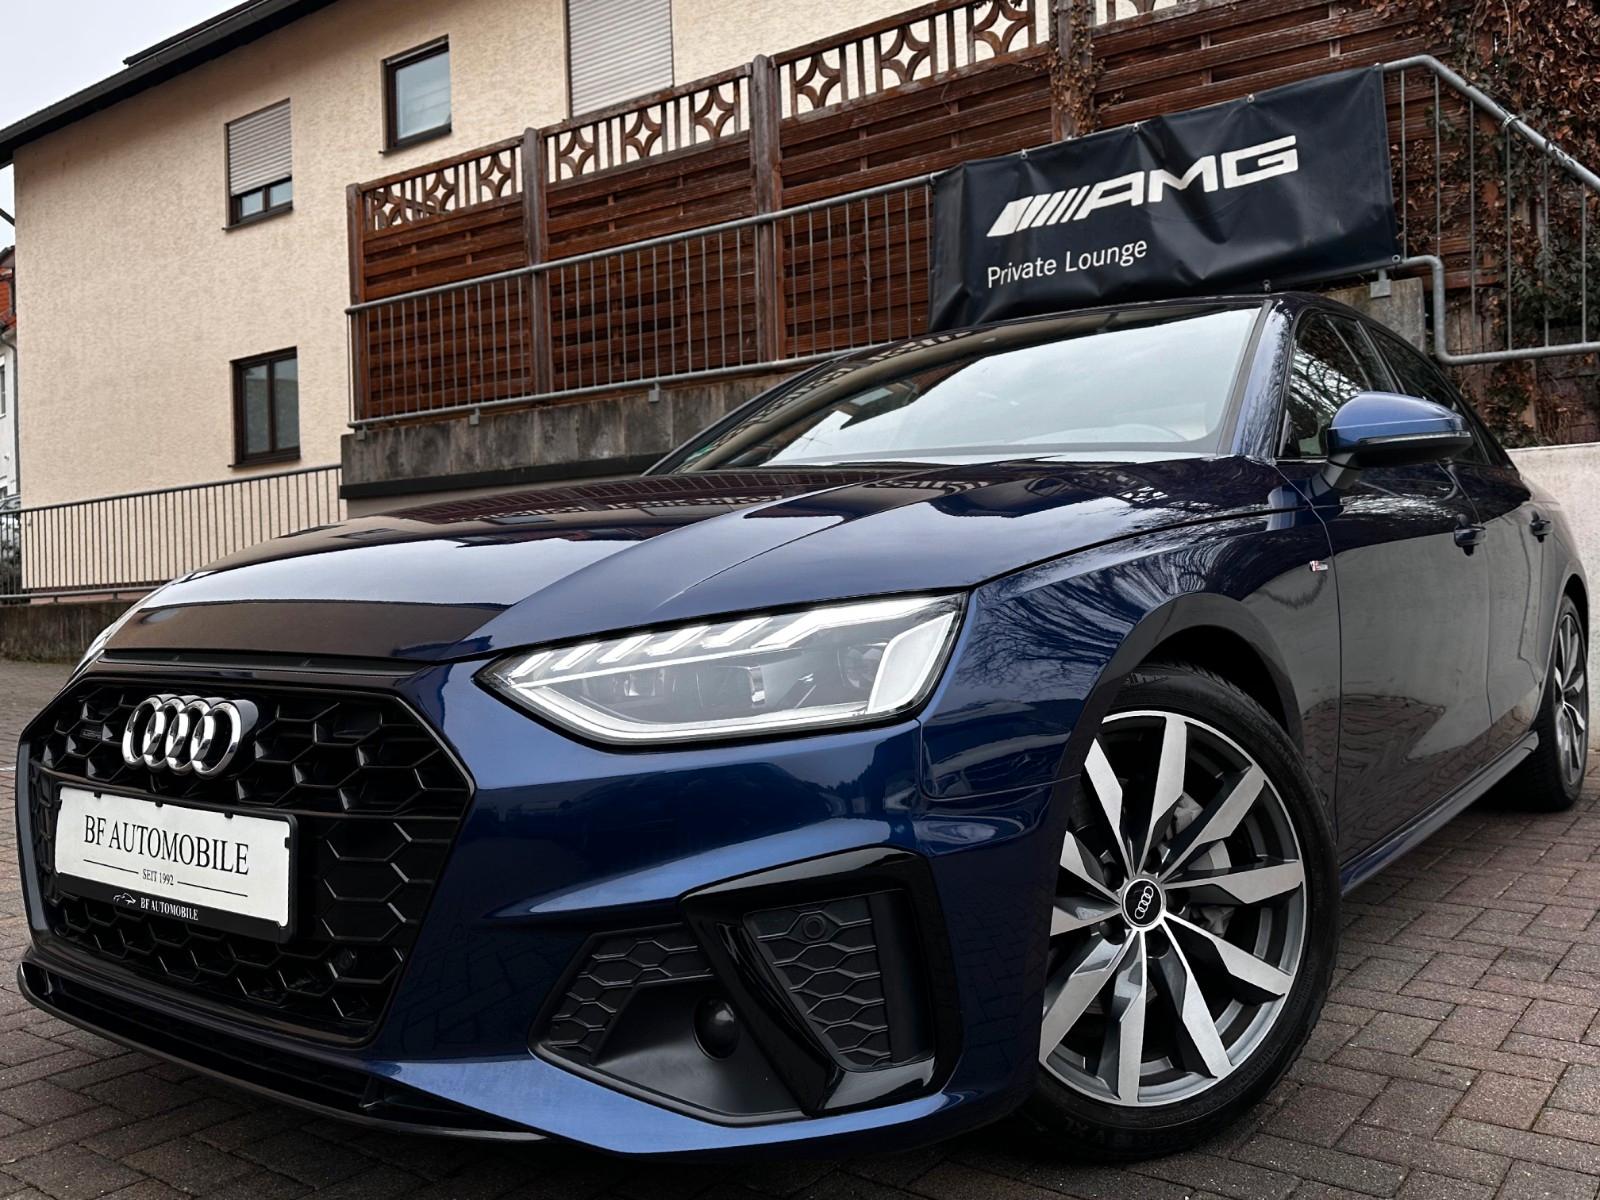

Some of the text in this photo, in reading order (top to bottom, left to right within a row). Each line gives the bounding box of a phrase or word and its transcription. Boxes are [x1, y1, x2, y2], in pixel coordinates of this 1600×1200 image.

[1072, 134, 1299, 222] AMG
[987, 239, 1148, 289] Private Lounge
[84, 814, 249, 875] BF AUTOMOBILE
[142, 868, 174, 886] SEIT 1992
[140, 897, 199, 921] BF AUTOMOBILE
